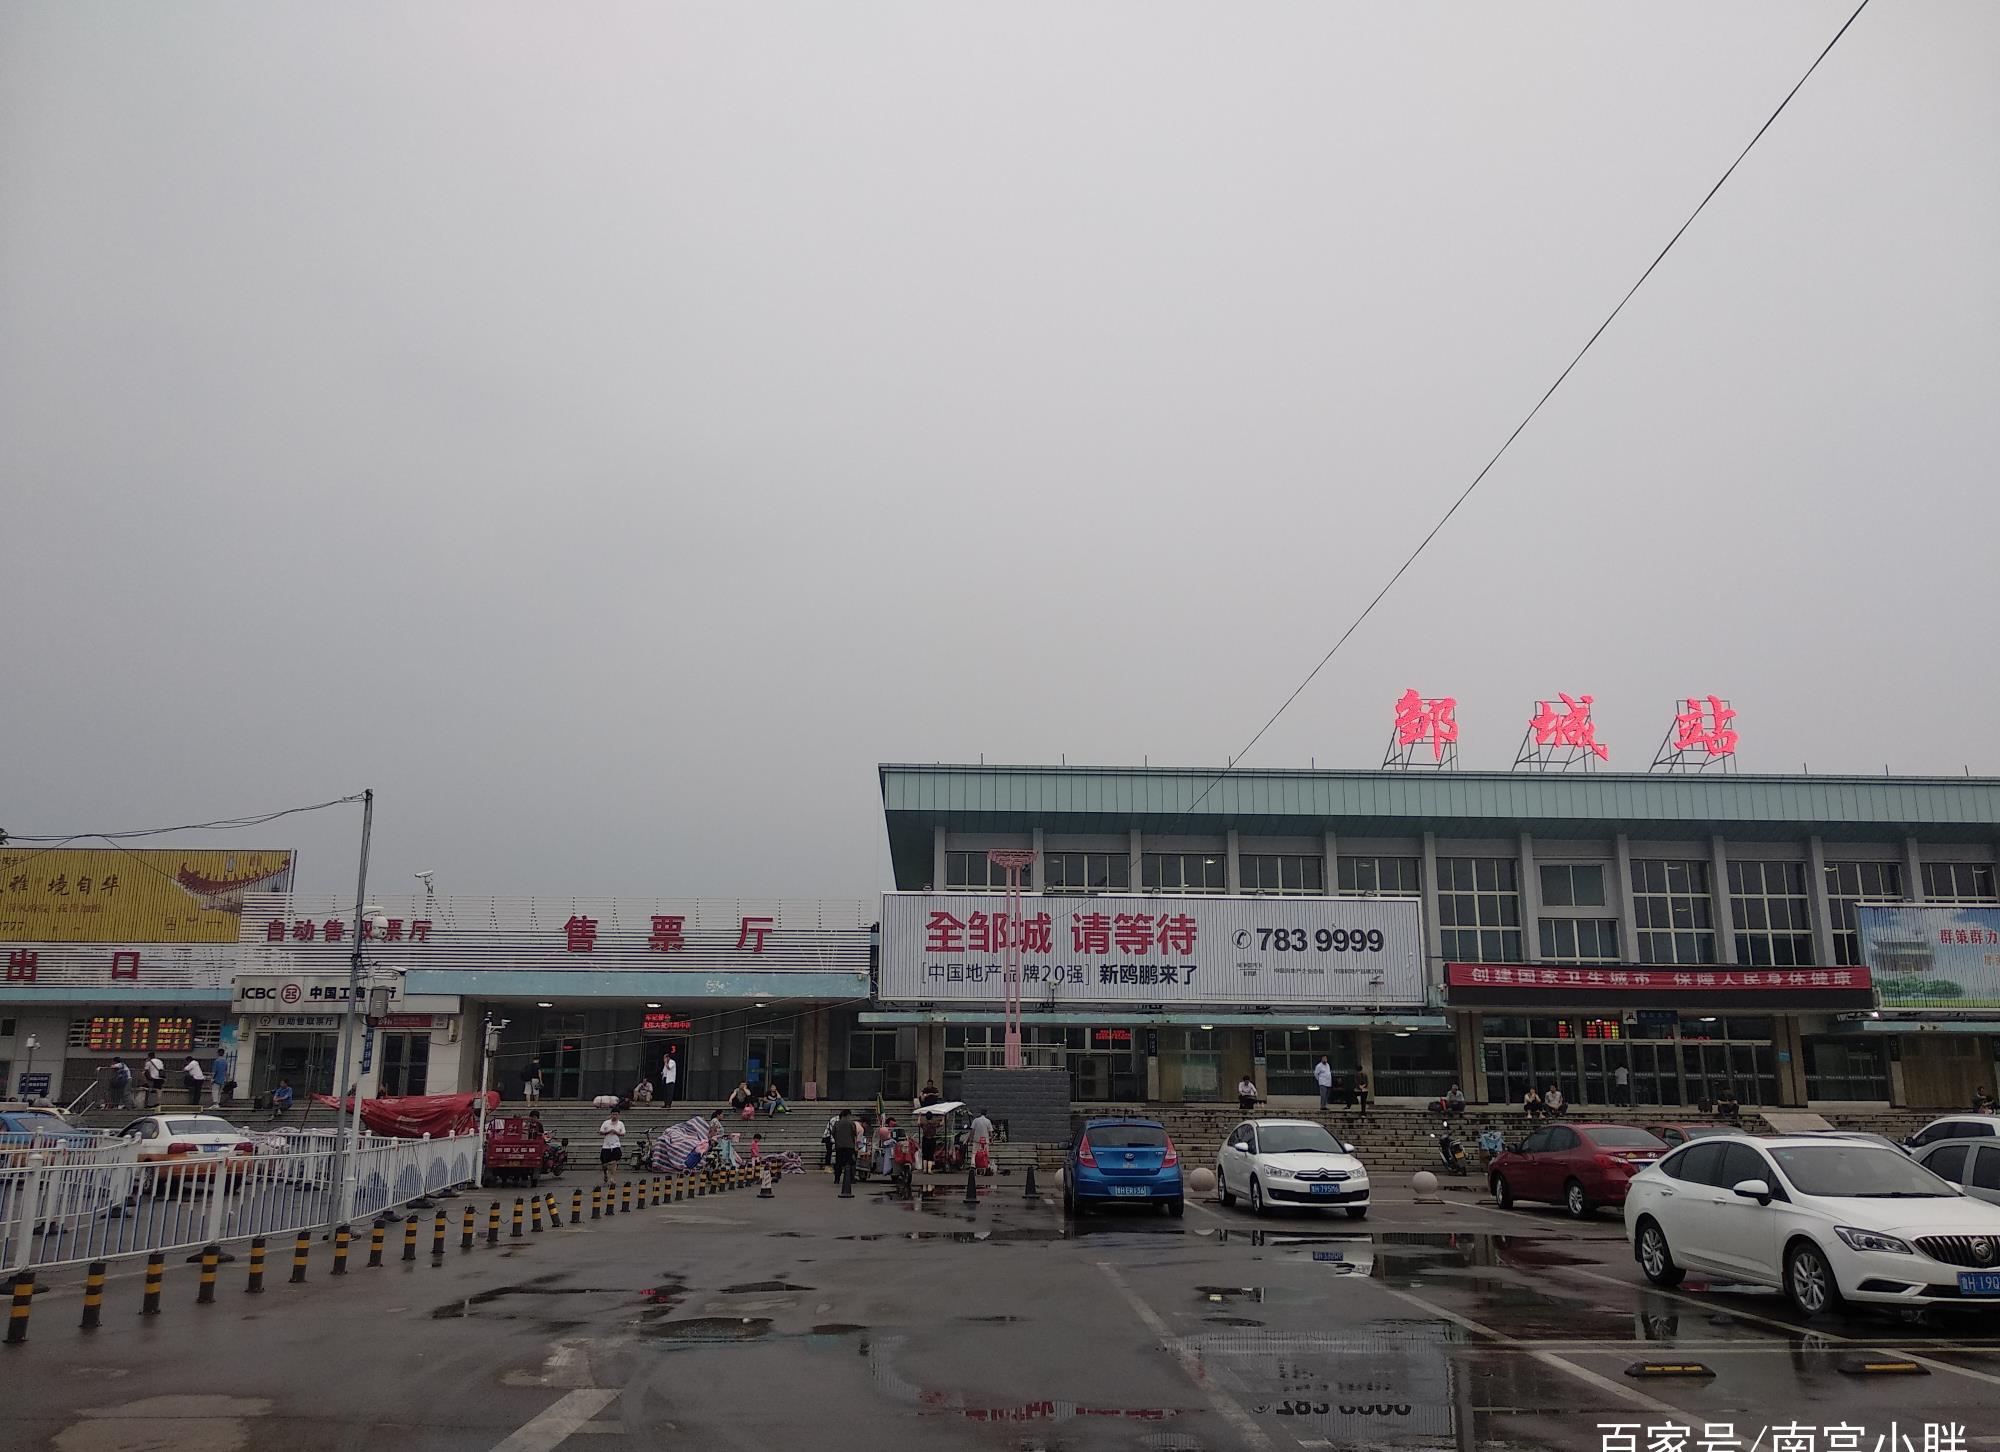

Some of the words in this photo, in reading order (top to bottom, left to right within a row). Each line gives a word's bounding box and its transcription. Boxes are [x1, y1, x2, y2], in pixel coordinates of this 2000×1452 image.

[1395, 688, 1740, 762] 邹城站
[563, 914, 774, 952] 售票厅
[925, 911, 1053, 954] 全邹城
[1071, 912, 1198, 955] 请等待
[1257, 928, 1308, 952] 783
[1315, 928, 1385, 952] 9999
[1940, 928, 1998, 945] 群策群力
[7, 949, 141, 982] 出口
[1099, 963, 1198, 986] 新鸥鹏来了
[1471, 966, 1652, 987] 创建国家卫生城市
[1673, 971, 1853, 986] 保障人民身体健康
[241, 987, 277, 999] ICBC
[309, 985, 397, 1000] 中国工商行
